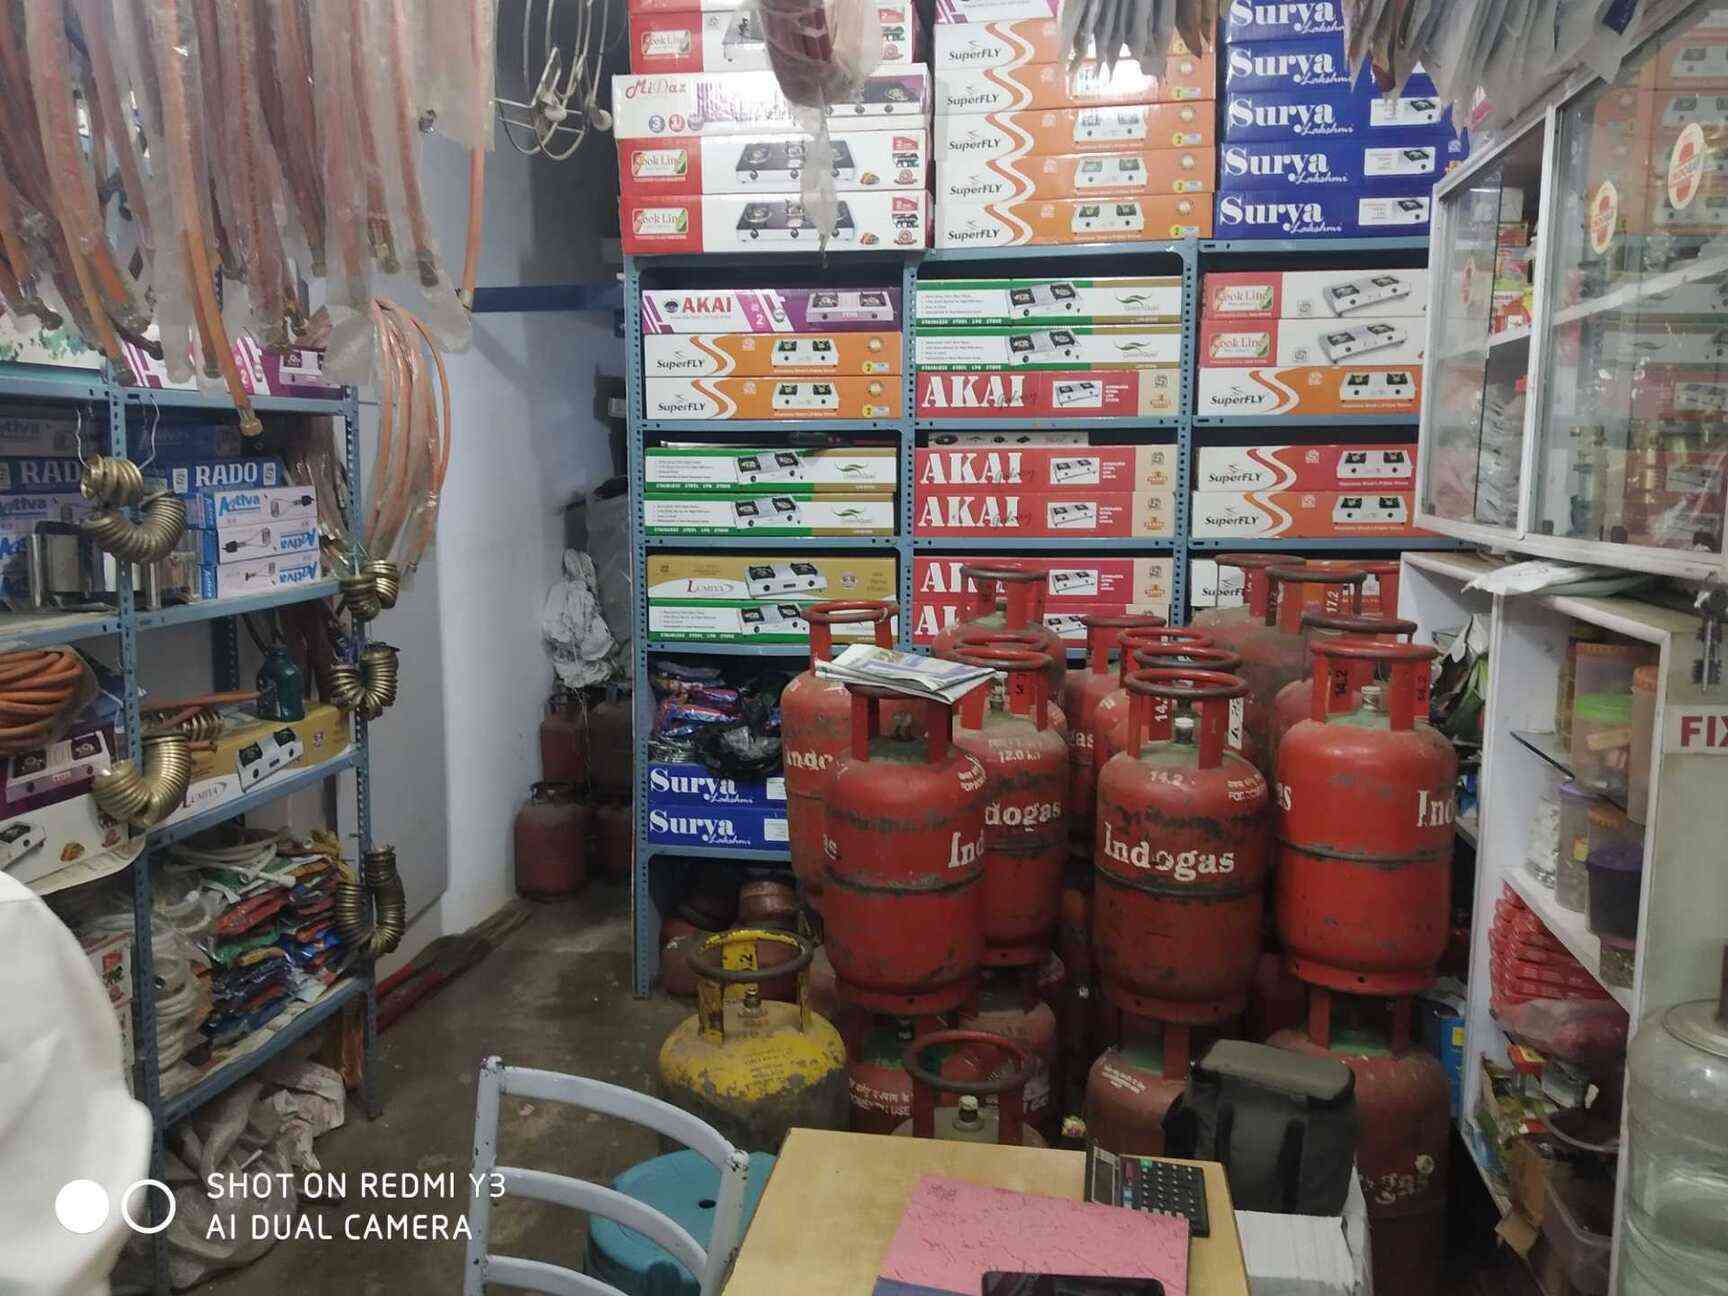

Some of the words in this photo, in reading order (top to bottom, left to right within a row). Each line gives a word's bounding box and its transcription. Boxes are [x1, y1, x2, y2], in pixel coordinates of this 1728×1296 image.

[1230, 0, 1335, 31] Surya
[949, 48, 1001, 61] SuperFLY
[1229, 48, 1334, 84] Surya
[947, 94, 999, 107] SuperFLY
[1230, 98, 1335, 134] Surya
[949, 139, 1000, 152] SuperFLY
[1225, 147, 1329, 183] Surya
[950, 184, 1002, 197] SuperFLY
[1219, 196, 1323, 232] Surya
[947, 229, 999, 242] SuperFLY
[682, 297, 732, 313] AKAI
[656, 359, 704, 371] SuperFLY
[922, 375, 1025, 408] AKAI
[1210, 395, 1264, 407] SuperFLY
[657, 402, 706, 414] SuperFLY
[20, 461, 81, 484] RAD
[196, 462, 258, 487] RADO
[920, 452, 1023, 484] AKAI
[1208, 472, 1263, 484] SuperFLY
[918, 496, 1020, 527] AKAI
[1205, 516, 1259, 528] SuperFLY
[1202, 586, 1245, 598] SuperF
[650, 767, 737, 802] Surya
[650, 808, 734, 842] Surya
[1104, 823, 1235, 882] Indogas
